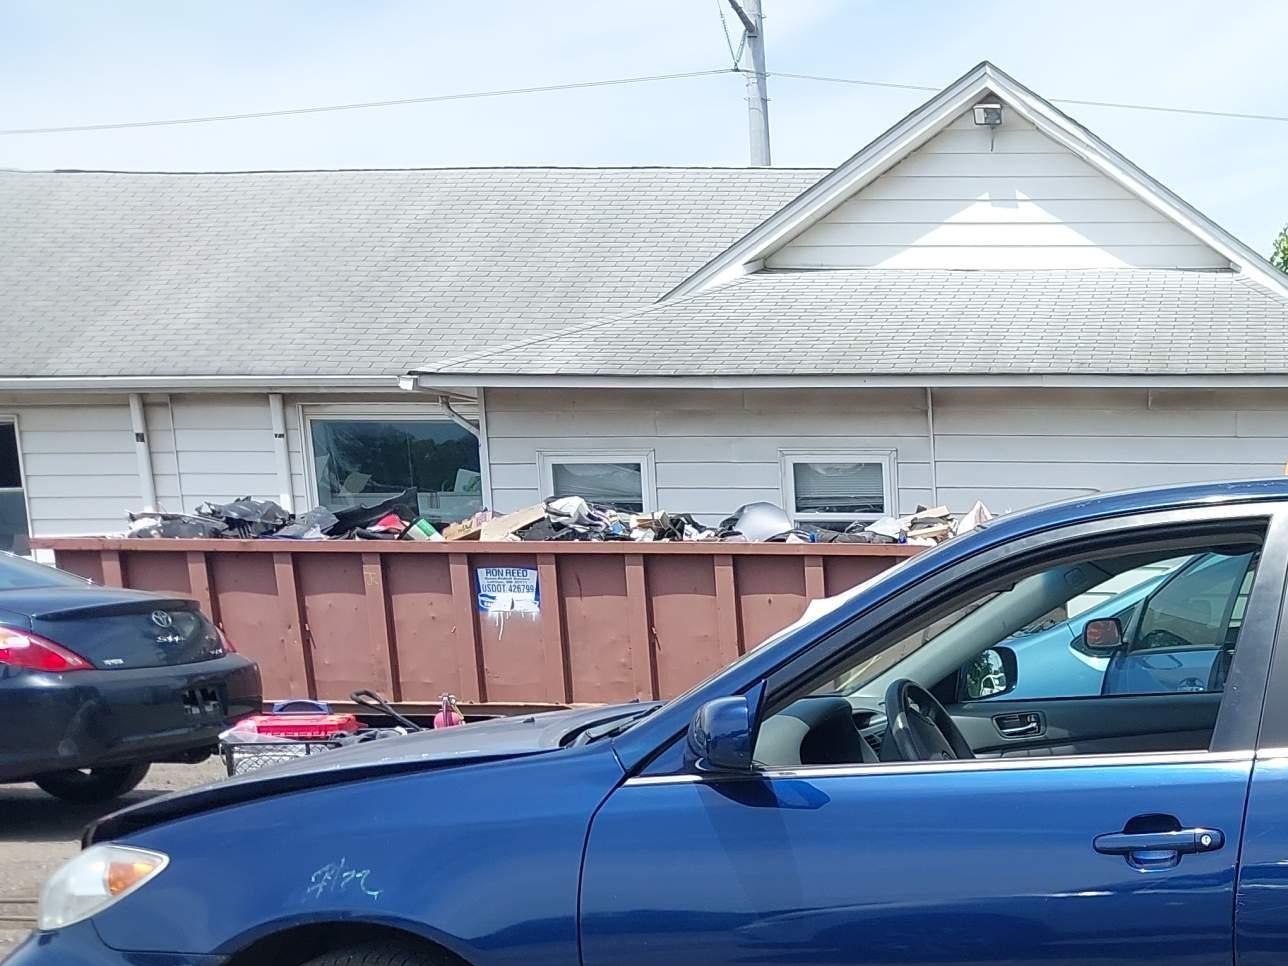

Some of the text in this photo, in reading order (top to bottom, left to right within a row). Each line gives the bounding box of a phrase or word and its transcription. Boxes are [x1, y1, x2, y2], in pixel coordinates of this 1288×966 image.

[486, 569, 528, 577] RON REED
[482, 584, 506, 592] USDOT
